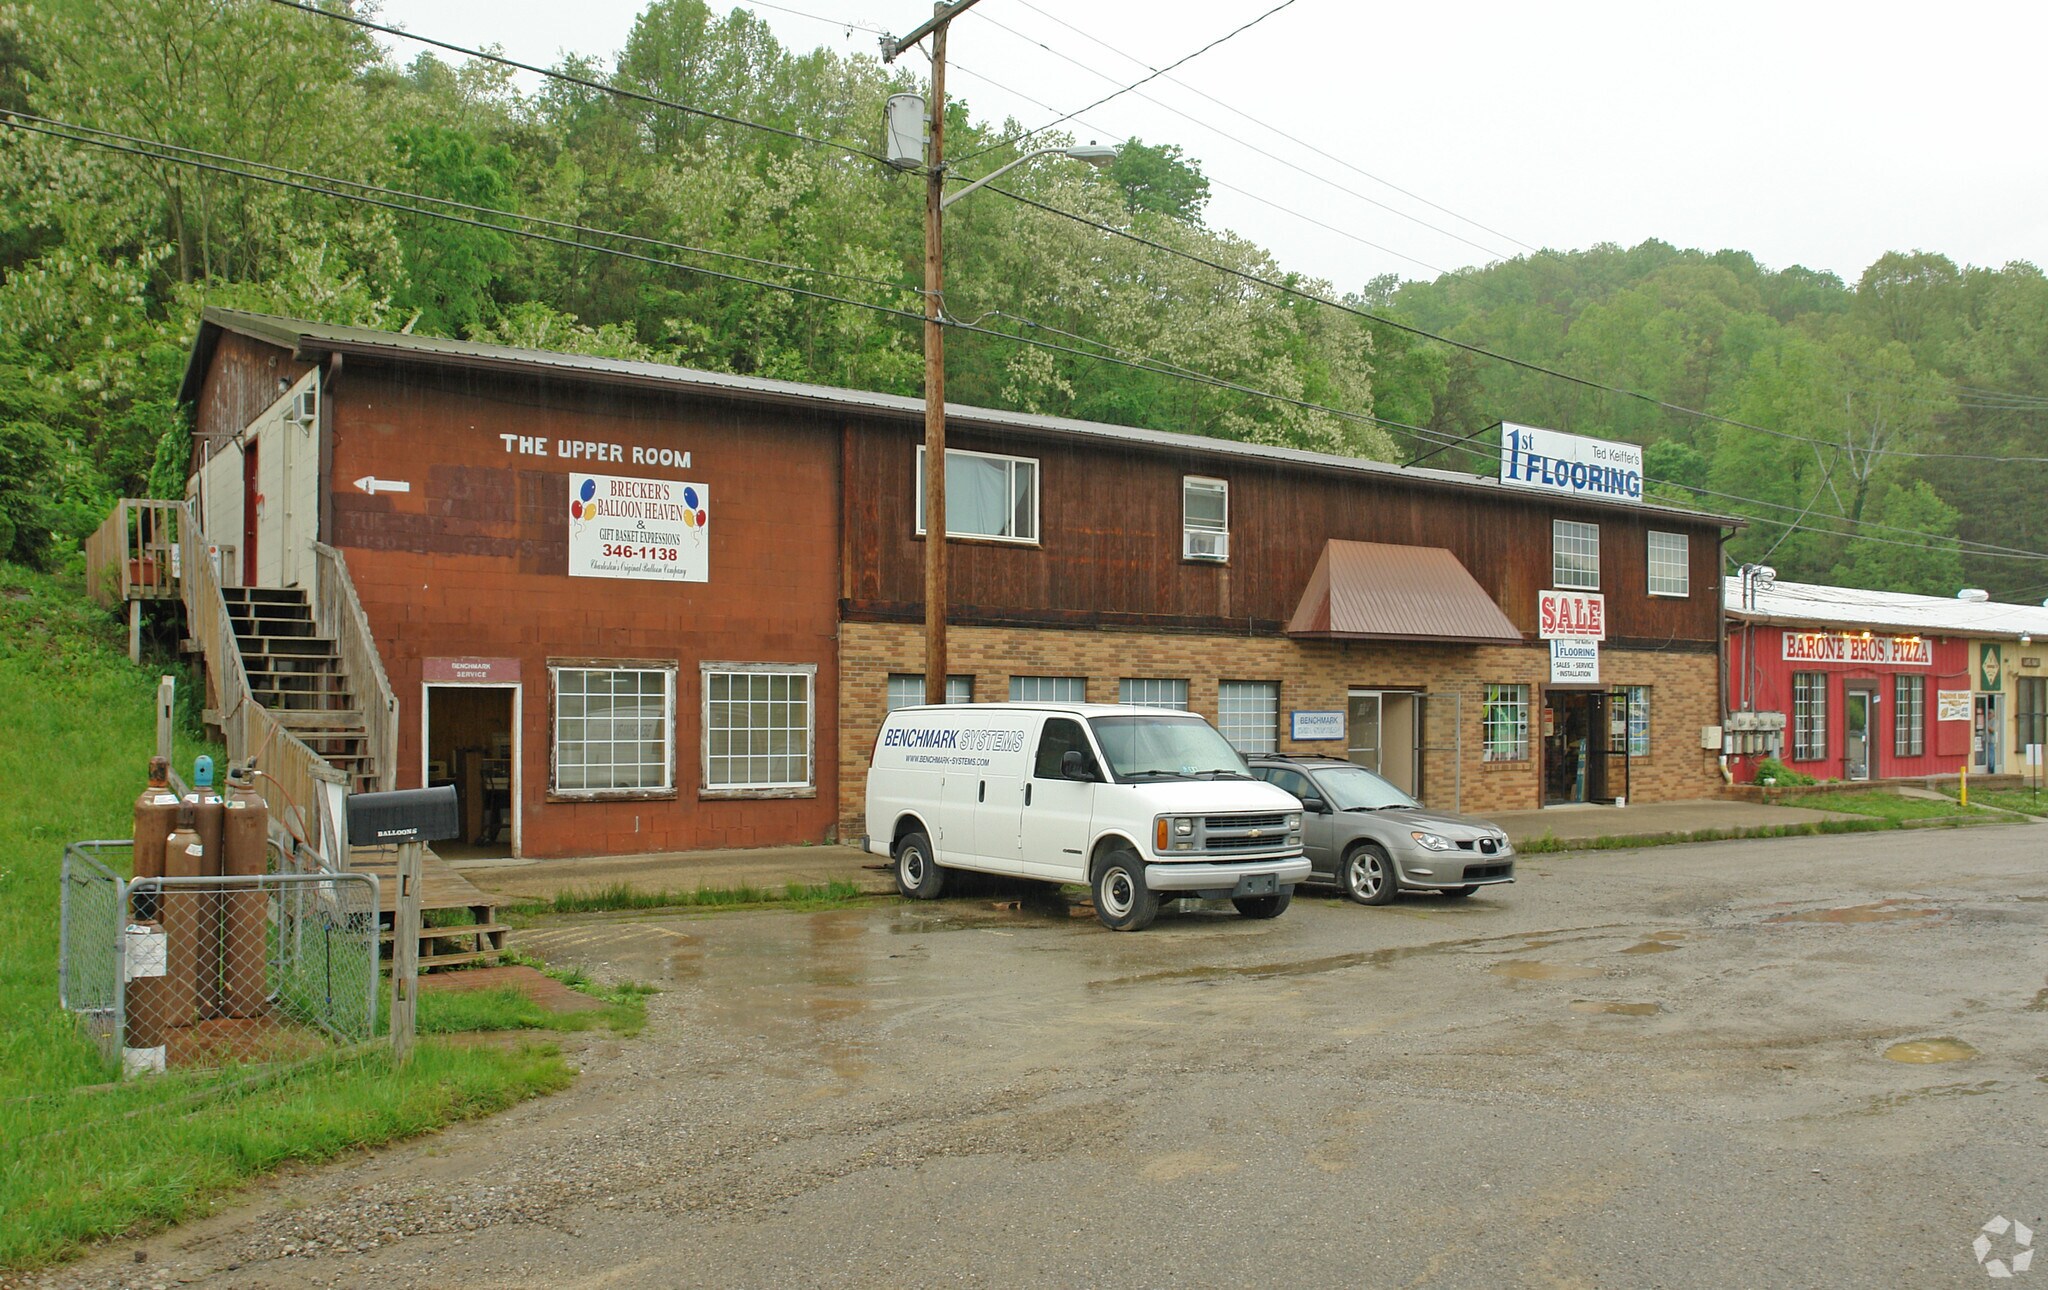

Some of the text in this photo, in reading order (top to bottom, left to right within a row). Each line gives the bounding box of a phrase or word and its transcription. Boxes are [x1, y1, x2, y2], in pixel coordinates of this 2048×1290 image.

[499, 433, 691, 468] THE UPPER ROOM
[1505, 429, 1534, 480] 1st
[1592, 445, 1640, 465] Ted Keiffer's
[1526, 453, 1640, 497] FLOORING
[610, 480, 670, 500] BRECKER'S
[597, 499, 683, 521] BALLOON HEAVEN
[636, 519, 646, 529] &
[599, 528, 681, 546] GIFT BASKET EXPRESSIONS
[602, 543, 678, 561] 346-1138
[590, 559, 687, 578] Charleston's Original Balloon Company
[1541, 596, 1602, 635] SALE
[1560, 647, 1595, 657] FLOORING
[1786, 634, 1845, 660] BARONE
[1892, 640, 1929, 663] PIZZA
[451, 662, 491, 670] BENCHMARK
[1299, 716, 1339, 725] BENCHMARK
[884, 728, 1024, 752] BENCHMARK SYSTEMS
[905, 754, 990, 767] WWW.BENCHMARK-SYSTEMS.COM
[377, 827, 418, 837] BALLOONS
